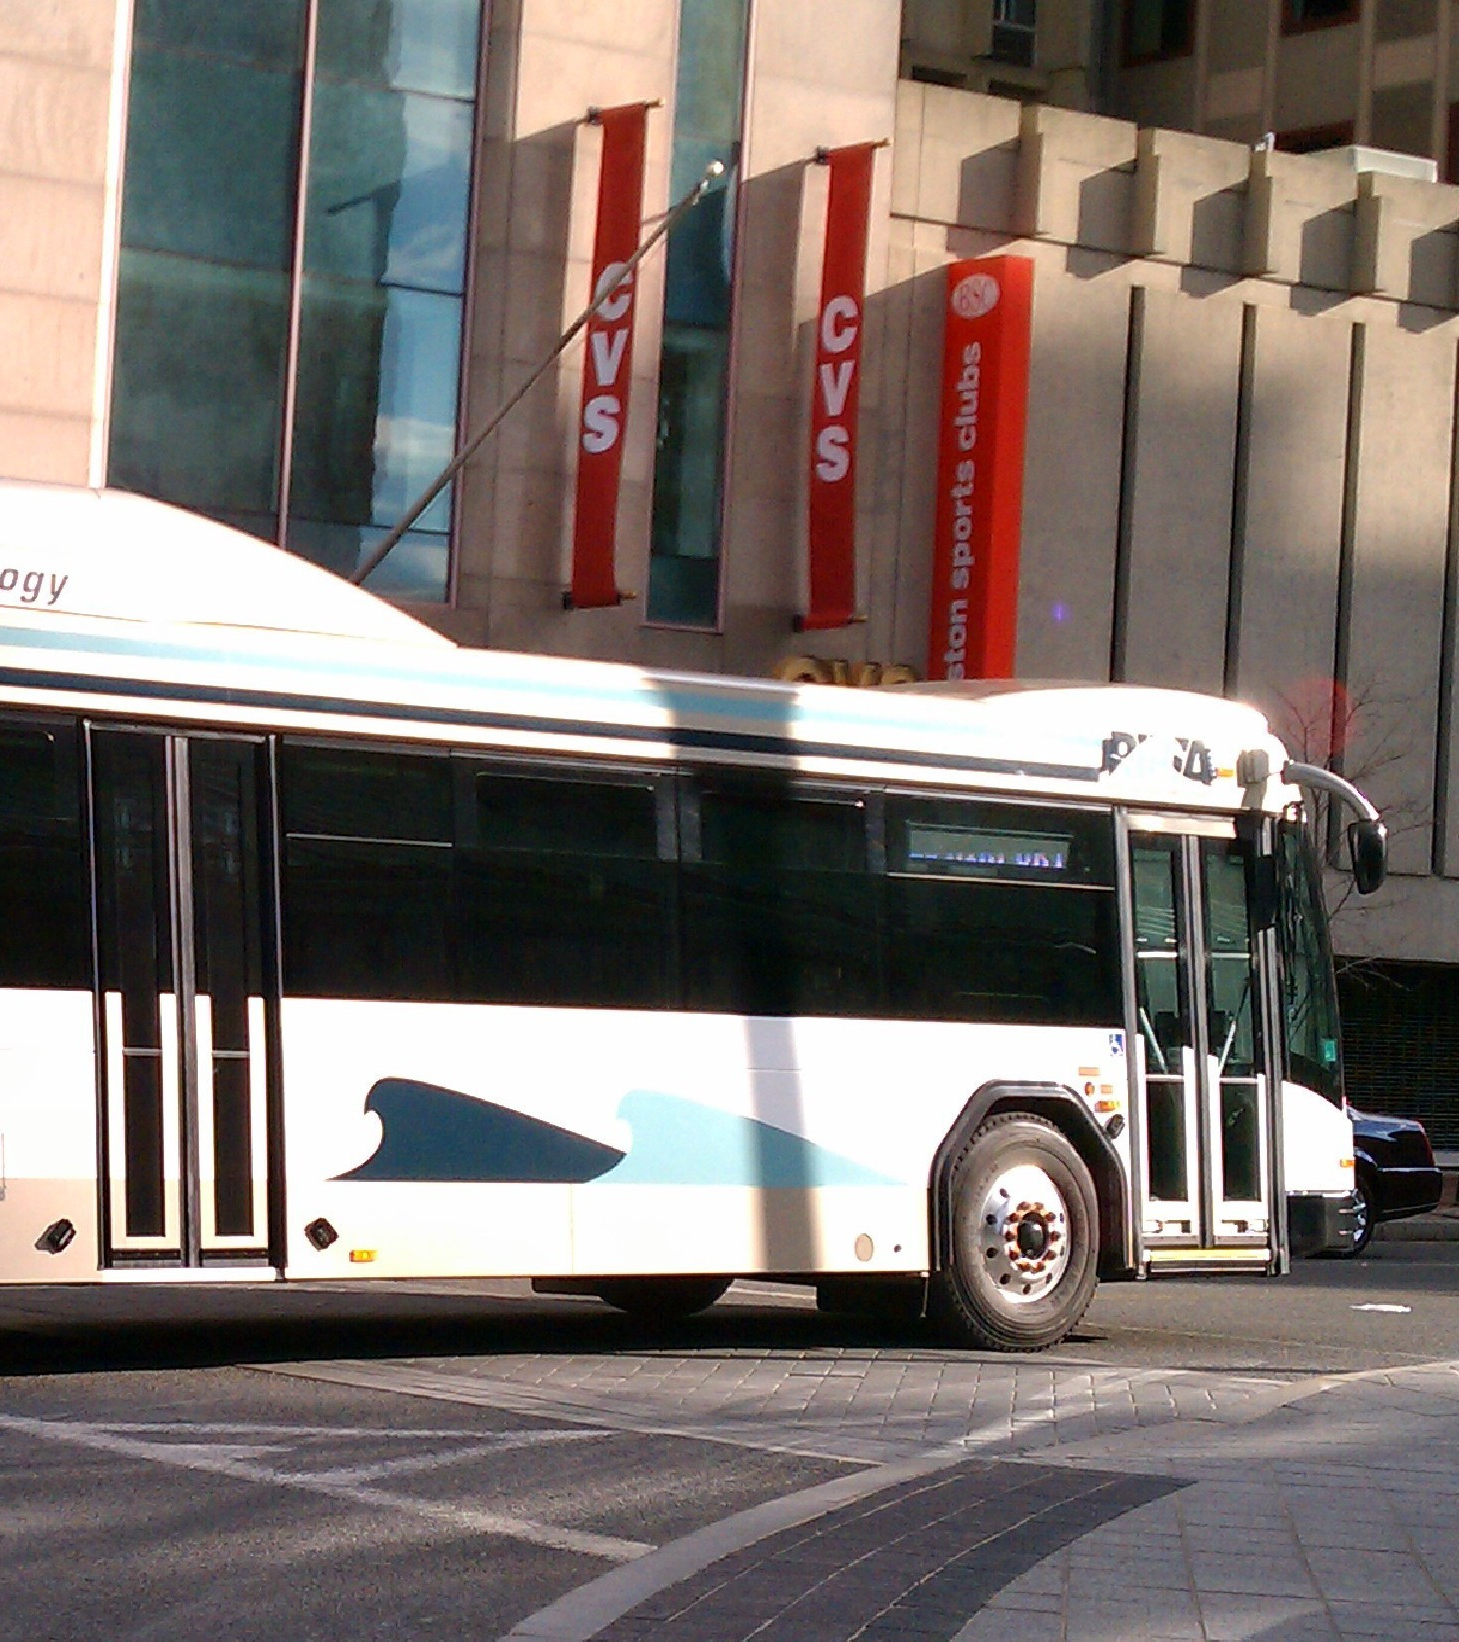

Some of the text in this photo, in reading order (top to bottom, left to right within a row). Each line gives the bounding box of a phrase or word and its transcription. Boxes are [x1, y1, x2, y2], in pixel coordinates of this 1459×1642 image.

[582, 262, 634, 454] CVS
[816, 295, 859, 483] CVS
[956, 340, 982, 452] clubs
[953, 459, 976, 590] sports
